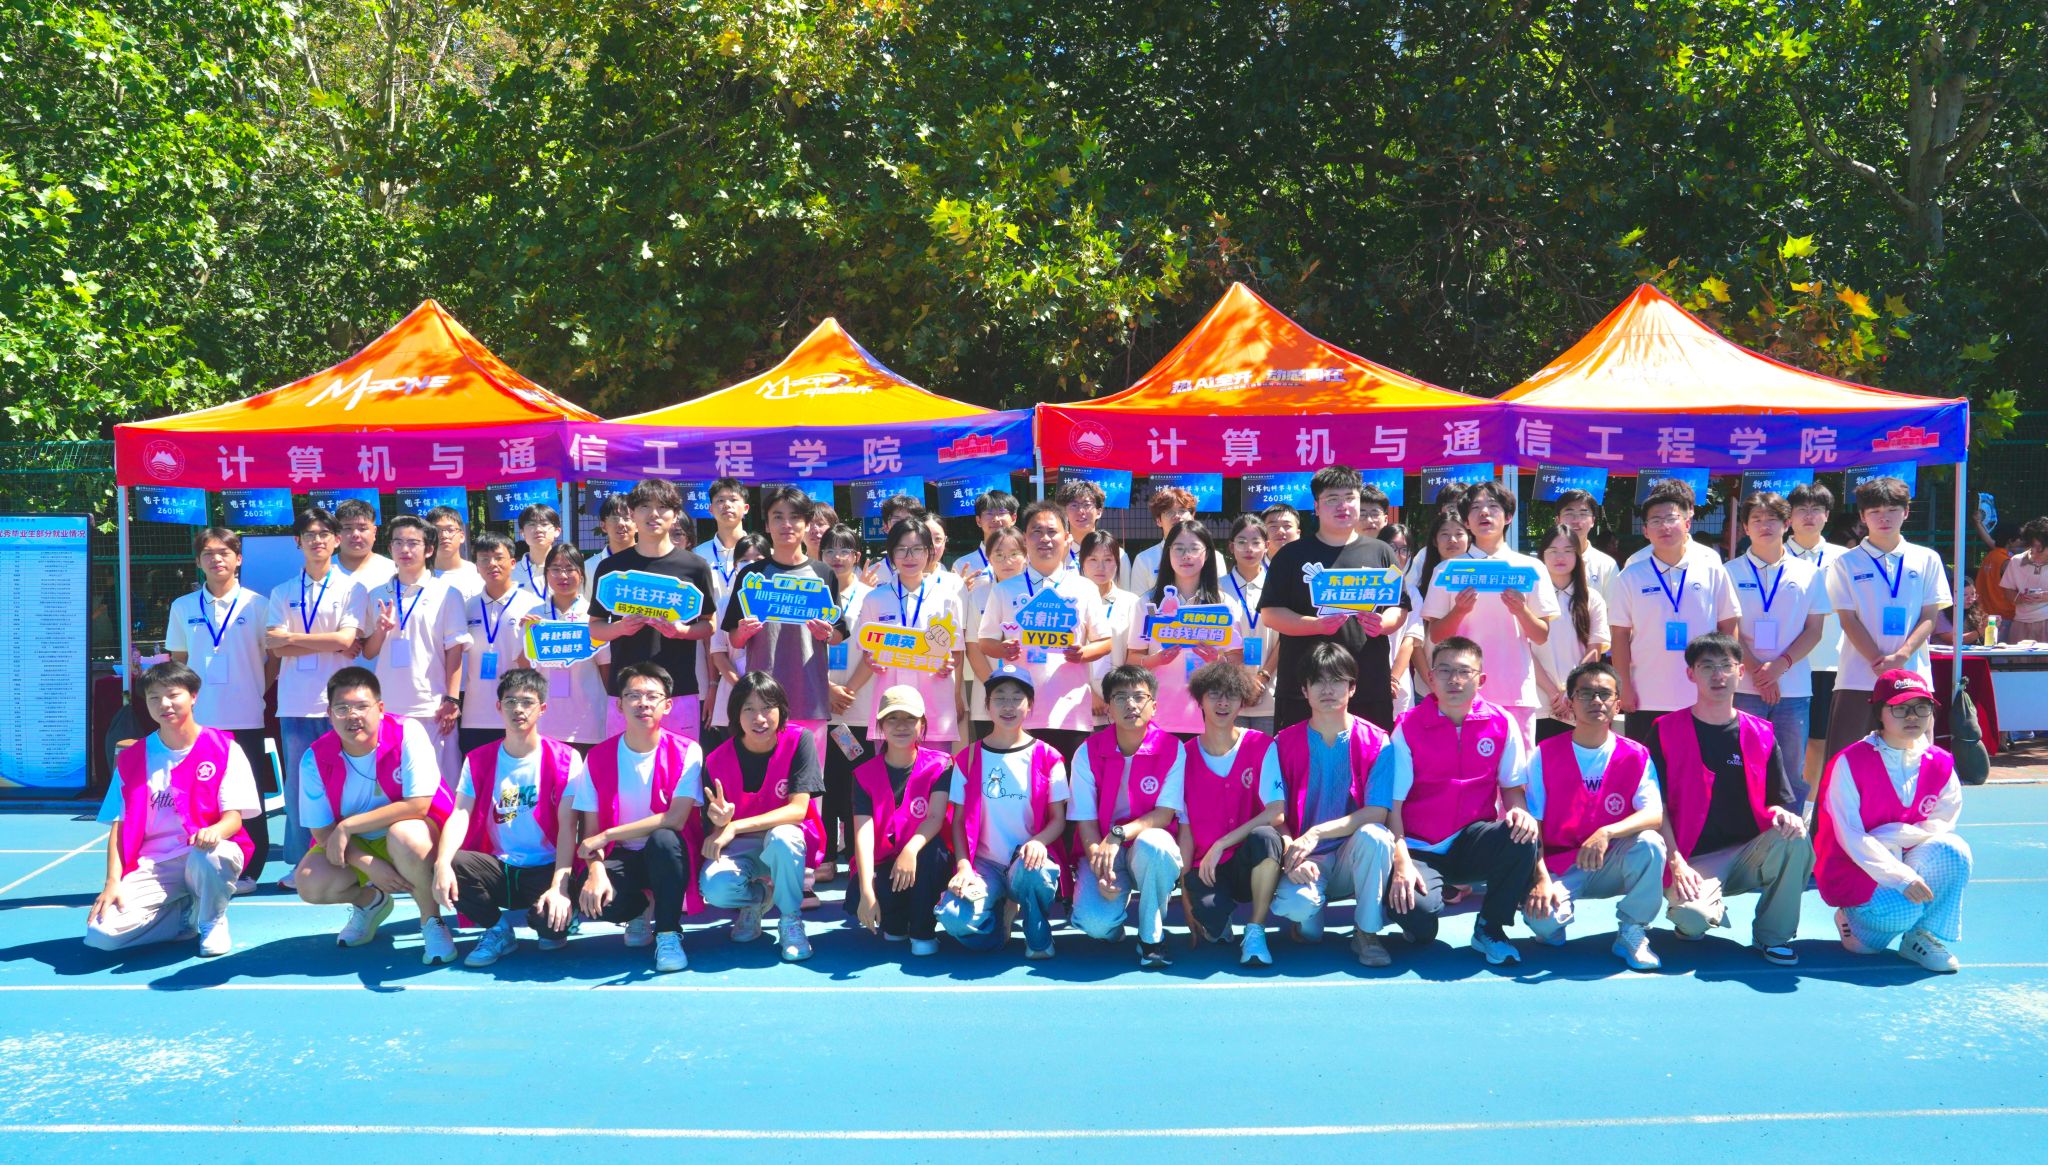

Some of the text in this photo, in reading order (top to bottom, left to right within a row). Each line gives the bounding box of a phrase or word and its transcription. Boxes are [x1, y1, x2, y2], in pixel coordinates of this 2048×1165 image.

[1147, 418, 1838, 466] 计算机与通信工程学院
[217, 433, 903, 483] 计算机与通信工程学院
[1542, 474, 1600, 487] 计算机科学与技术
[687, 490, 708, 501] 通信
[1247, 484, 1308, 494] 计算机科学与技术
[143, 495, 198, 508] 电子信息工程
[404, 497, 459, 508] 电子信息工程
[495, 490, 550, 503] 电子信息工程
[1263, 494, 1293, 503] 2603班
[229, 499, 285, 509] 电子信息工程
[157, 506, 184, 516] 2601班
[243, 510, 272, 518] 2602班
[615, 583, 683, 607] 计往开来
[1319, 587, 1395, 601] 永远满分
[617, 602, 670, 619] 码力全开ING
[540, 630, 583, 642] 奔赴新程
[867, 631, 918, 650] IT精英
[1026, 631, 1069, 646] YYDS
[540, 643, 584, 655] 不负韶华
